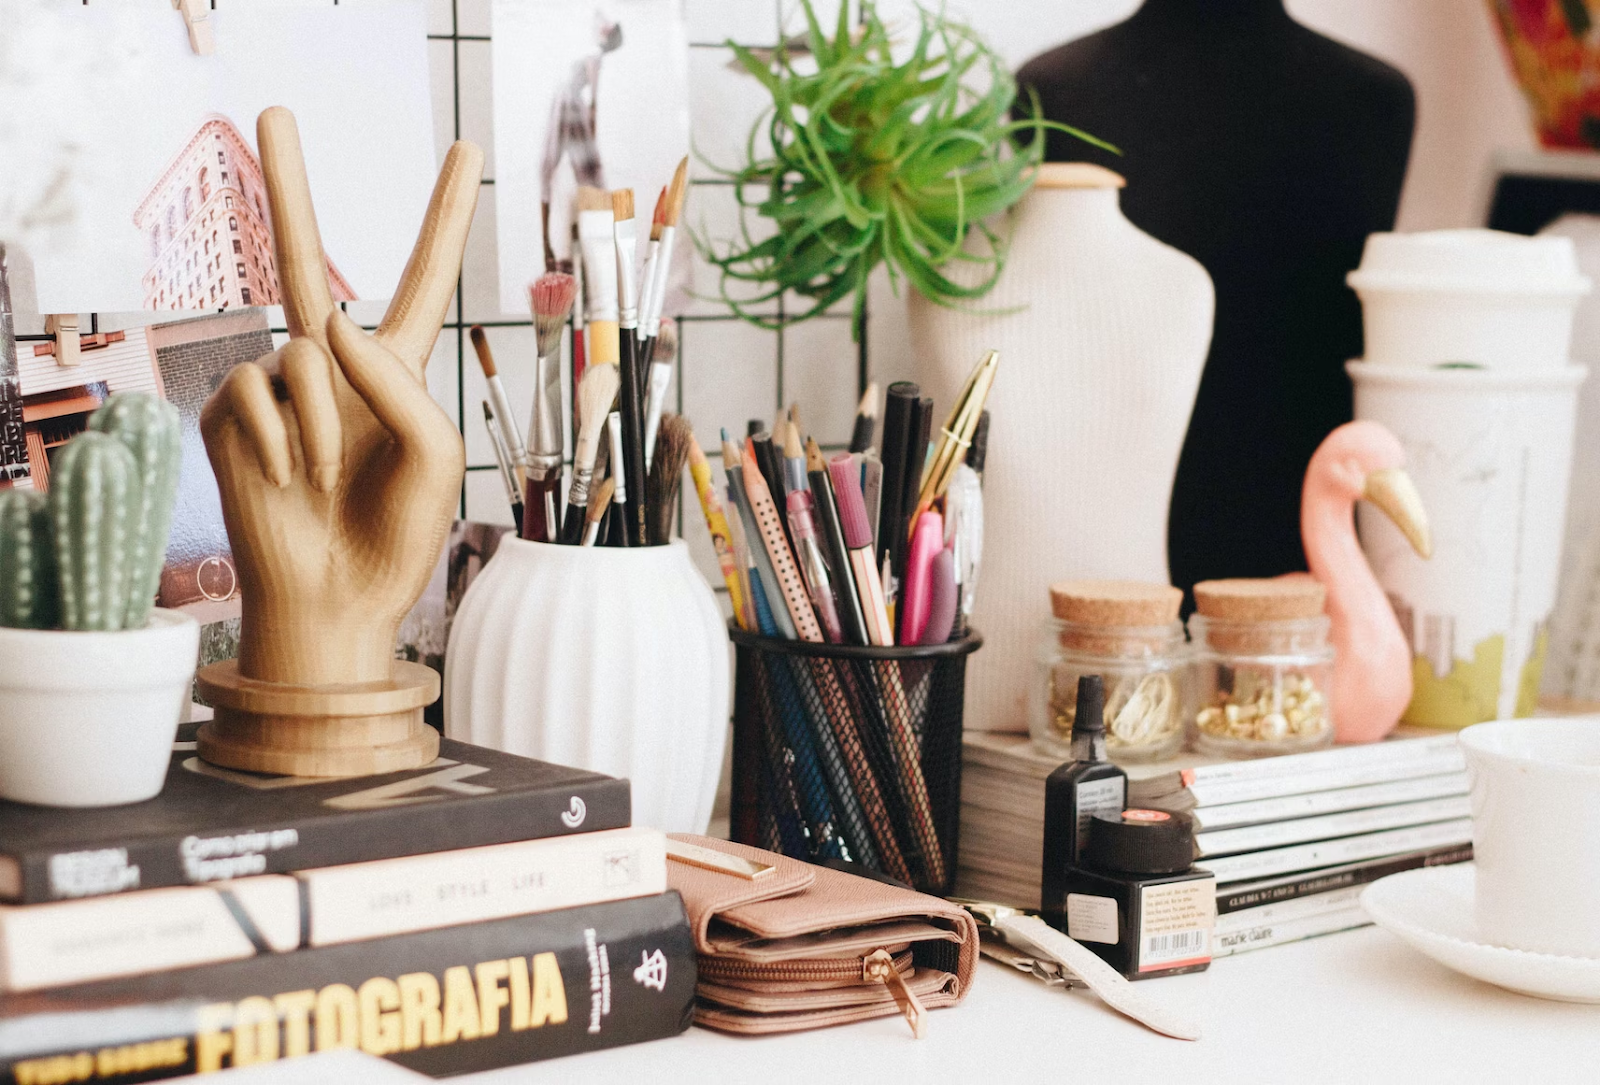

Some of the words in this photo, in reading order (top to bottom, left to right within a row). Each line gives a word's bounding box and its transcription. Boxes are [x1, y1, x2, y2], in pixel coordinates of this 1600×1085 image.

[437, 878, 488, 901] STYLE
[513, 870, 547, 891] LIFE
[1229, 893, 1259, 907] CLAUDIA
[1220, 933, 1246, 948] marie
[1248, 927, 1273, 941] claire
[197, 951, 568, 1073] FOTOGRAFIA
